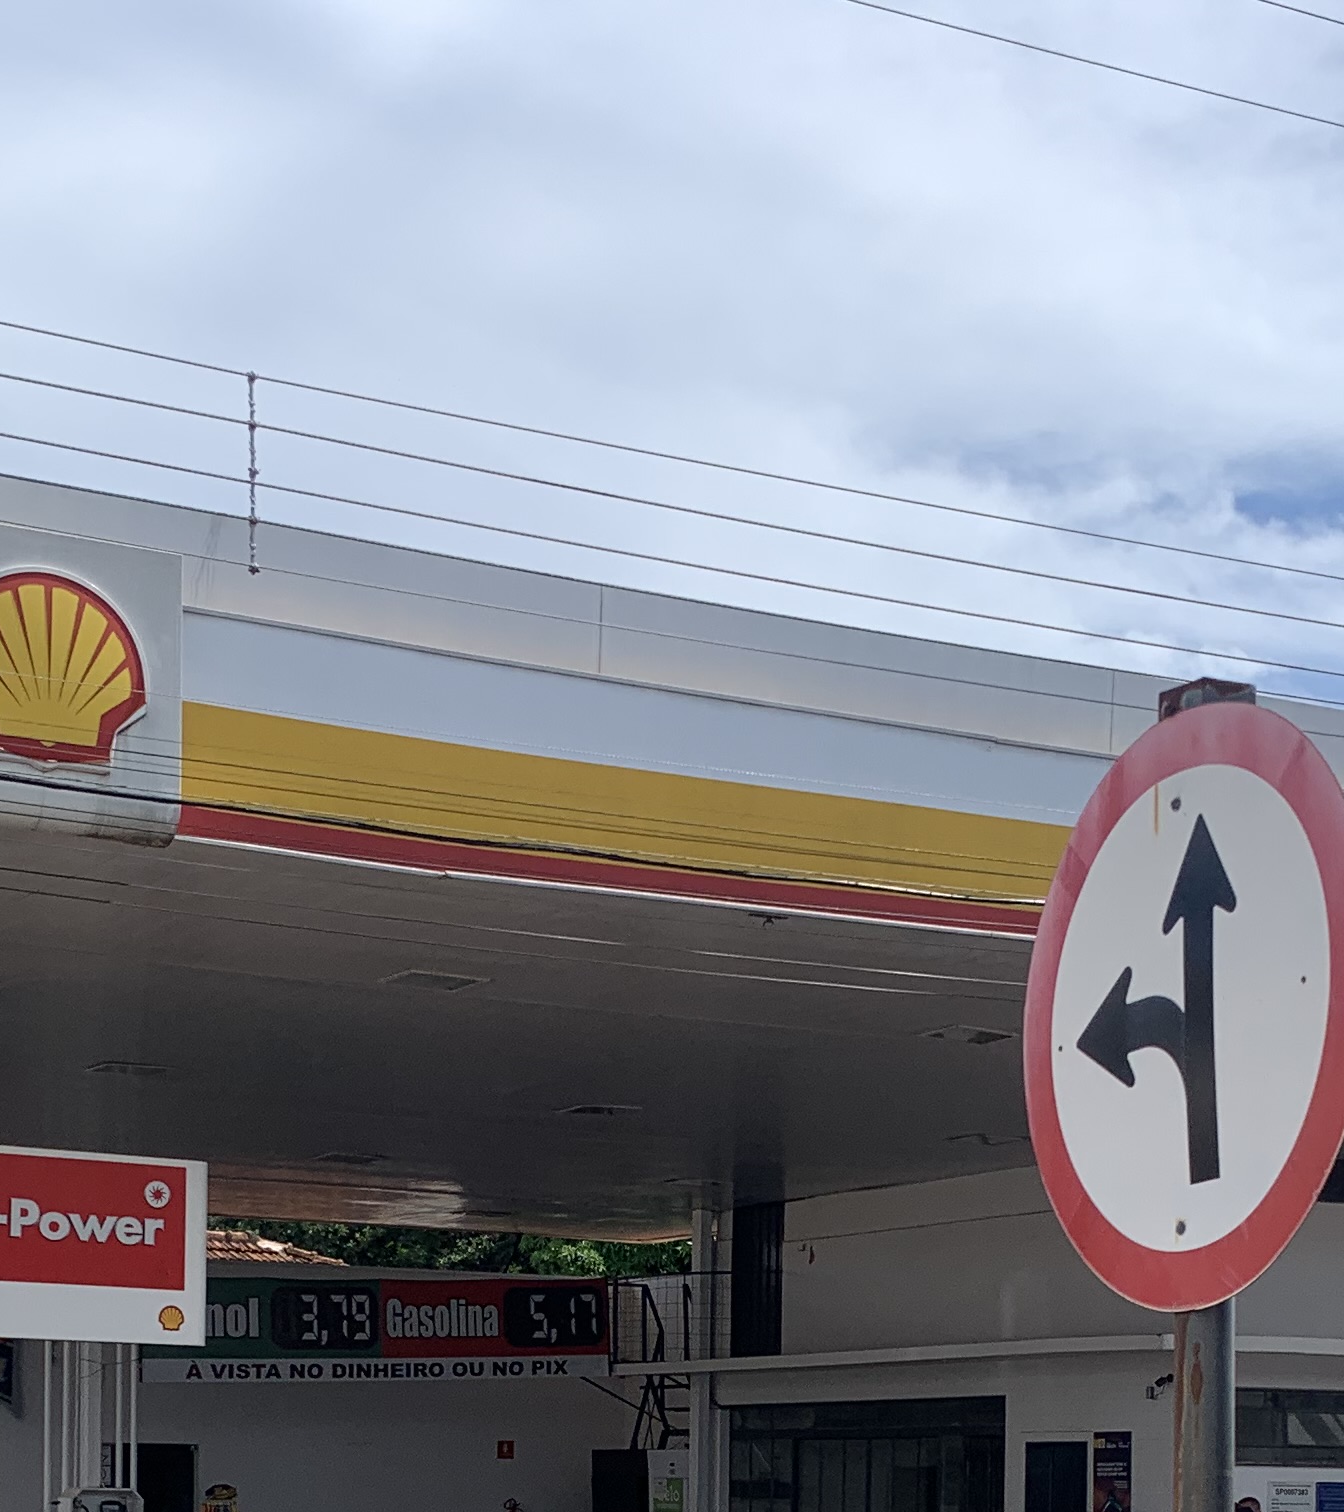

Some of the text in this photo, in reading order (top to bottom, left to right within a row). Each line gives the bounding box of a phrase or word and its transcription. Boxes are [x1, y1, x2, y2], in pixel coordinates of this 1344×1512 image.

[205, 1294, 598, 1346] nol 3,79 Gasolina 5,17
[185, 1359, 568, 1381] À VISTA NO DINHEIRO OU NO PIX
